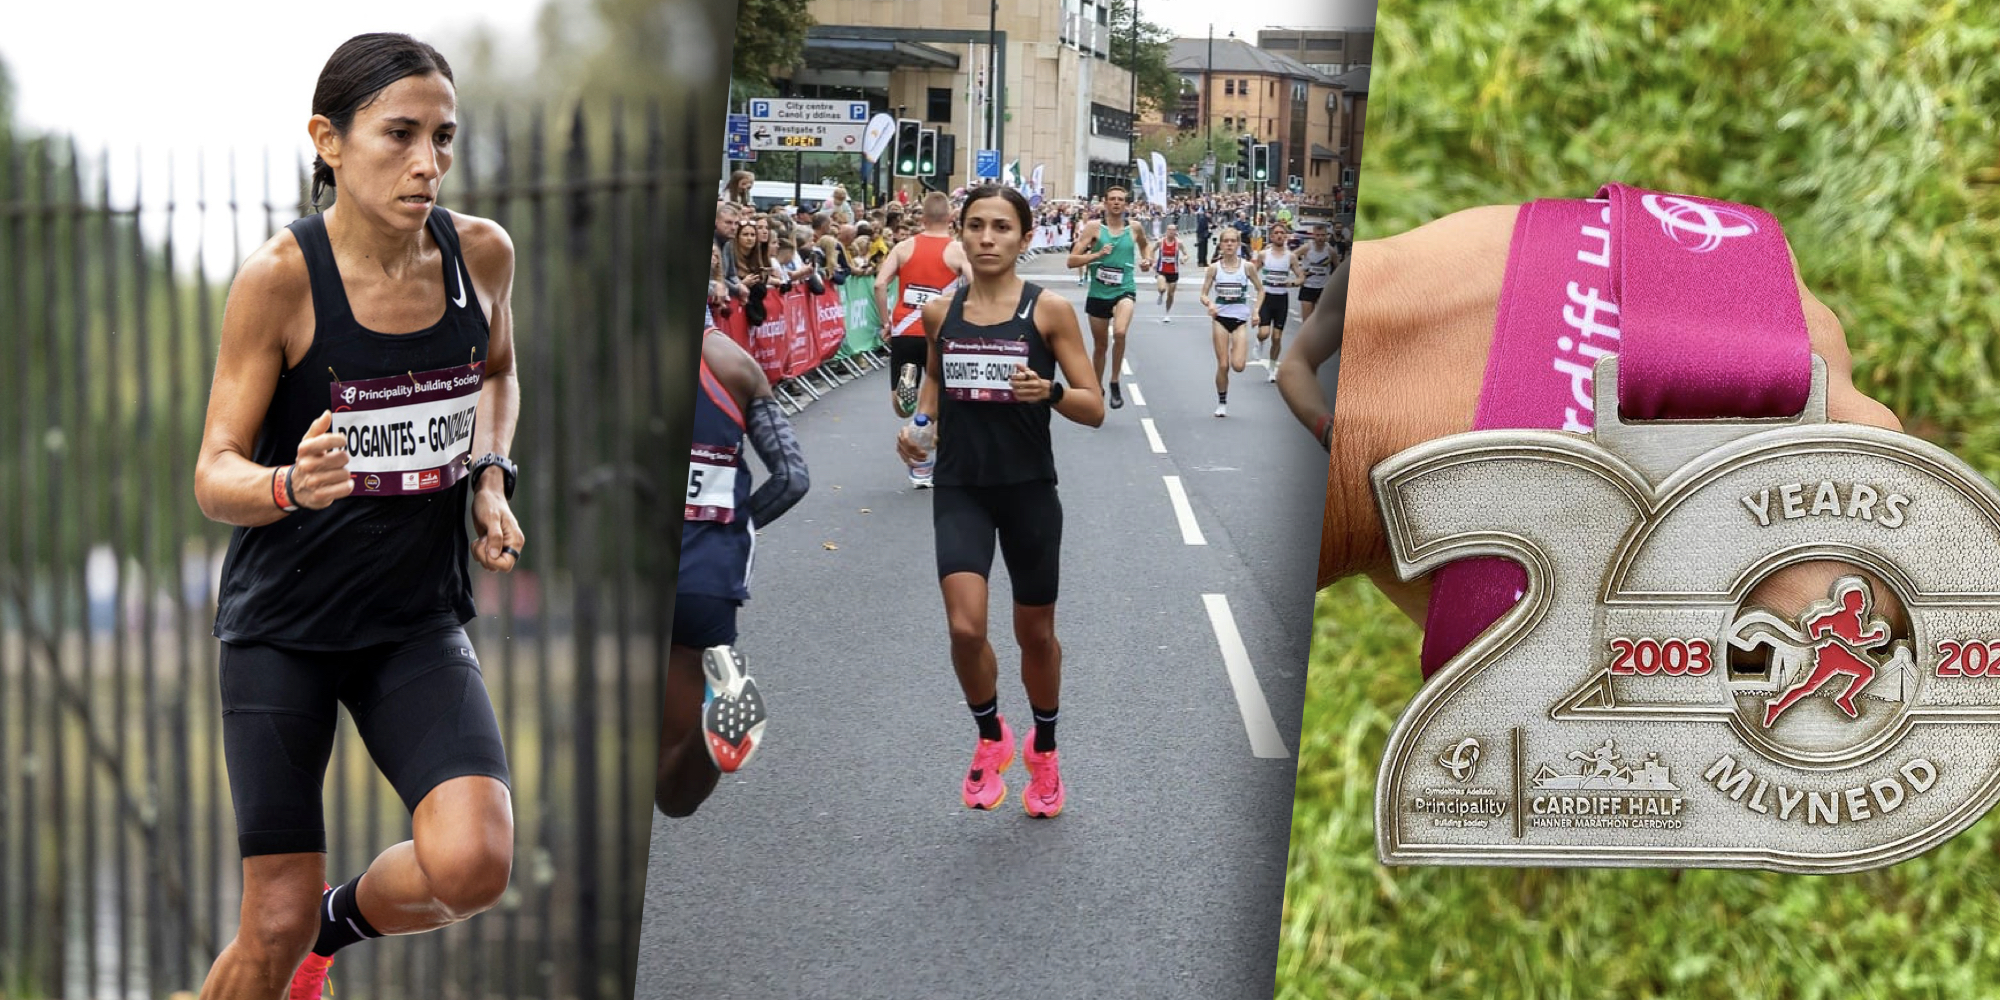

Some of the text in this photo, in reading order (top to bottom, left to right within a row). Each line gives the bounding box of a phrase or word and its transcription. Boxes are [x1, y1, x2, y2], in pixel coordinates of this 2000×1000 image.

[778, 110, 801, 119] Canol
[813, 111, 841, 119] ddinas
[785, 101, 803, 111] City
[773, 125, 826, 134] Westgate St
[784, 136, 815, 146] OPEN
[945, 362, 979, 381] BOGANTES
[358, 373, 481, 402] Principality Building Society
[1741, 480, 1911, 530] YEARS
[1608, 638, 1712, 677] 2003
[1704, 753, 1938, 826] MLYNEDD
[1414, 797, 1507, 818] Principality
[1532, 796, 1683, 816] CARDIFF HALF
[1434, 818, 1489, 829] Building Society
[1532, 818, 1683, 830] HANNER MARATHON CAERDYDD
